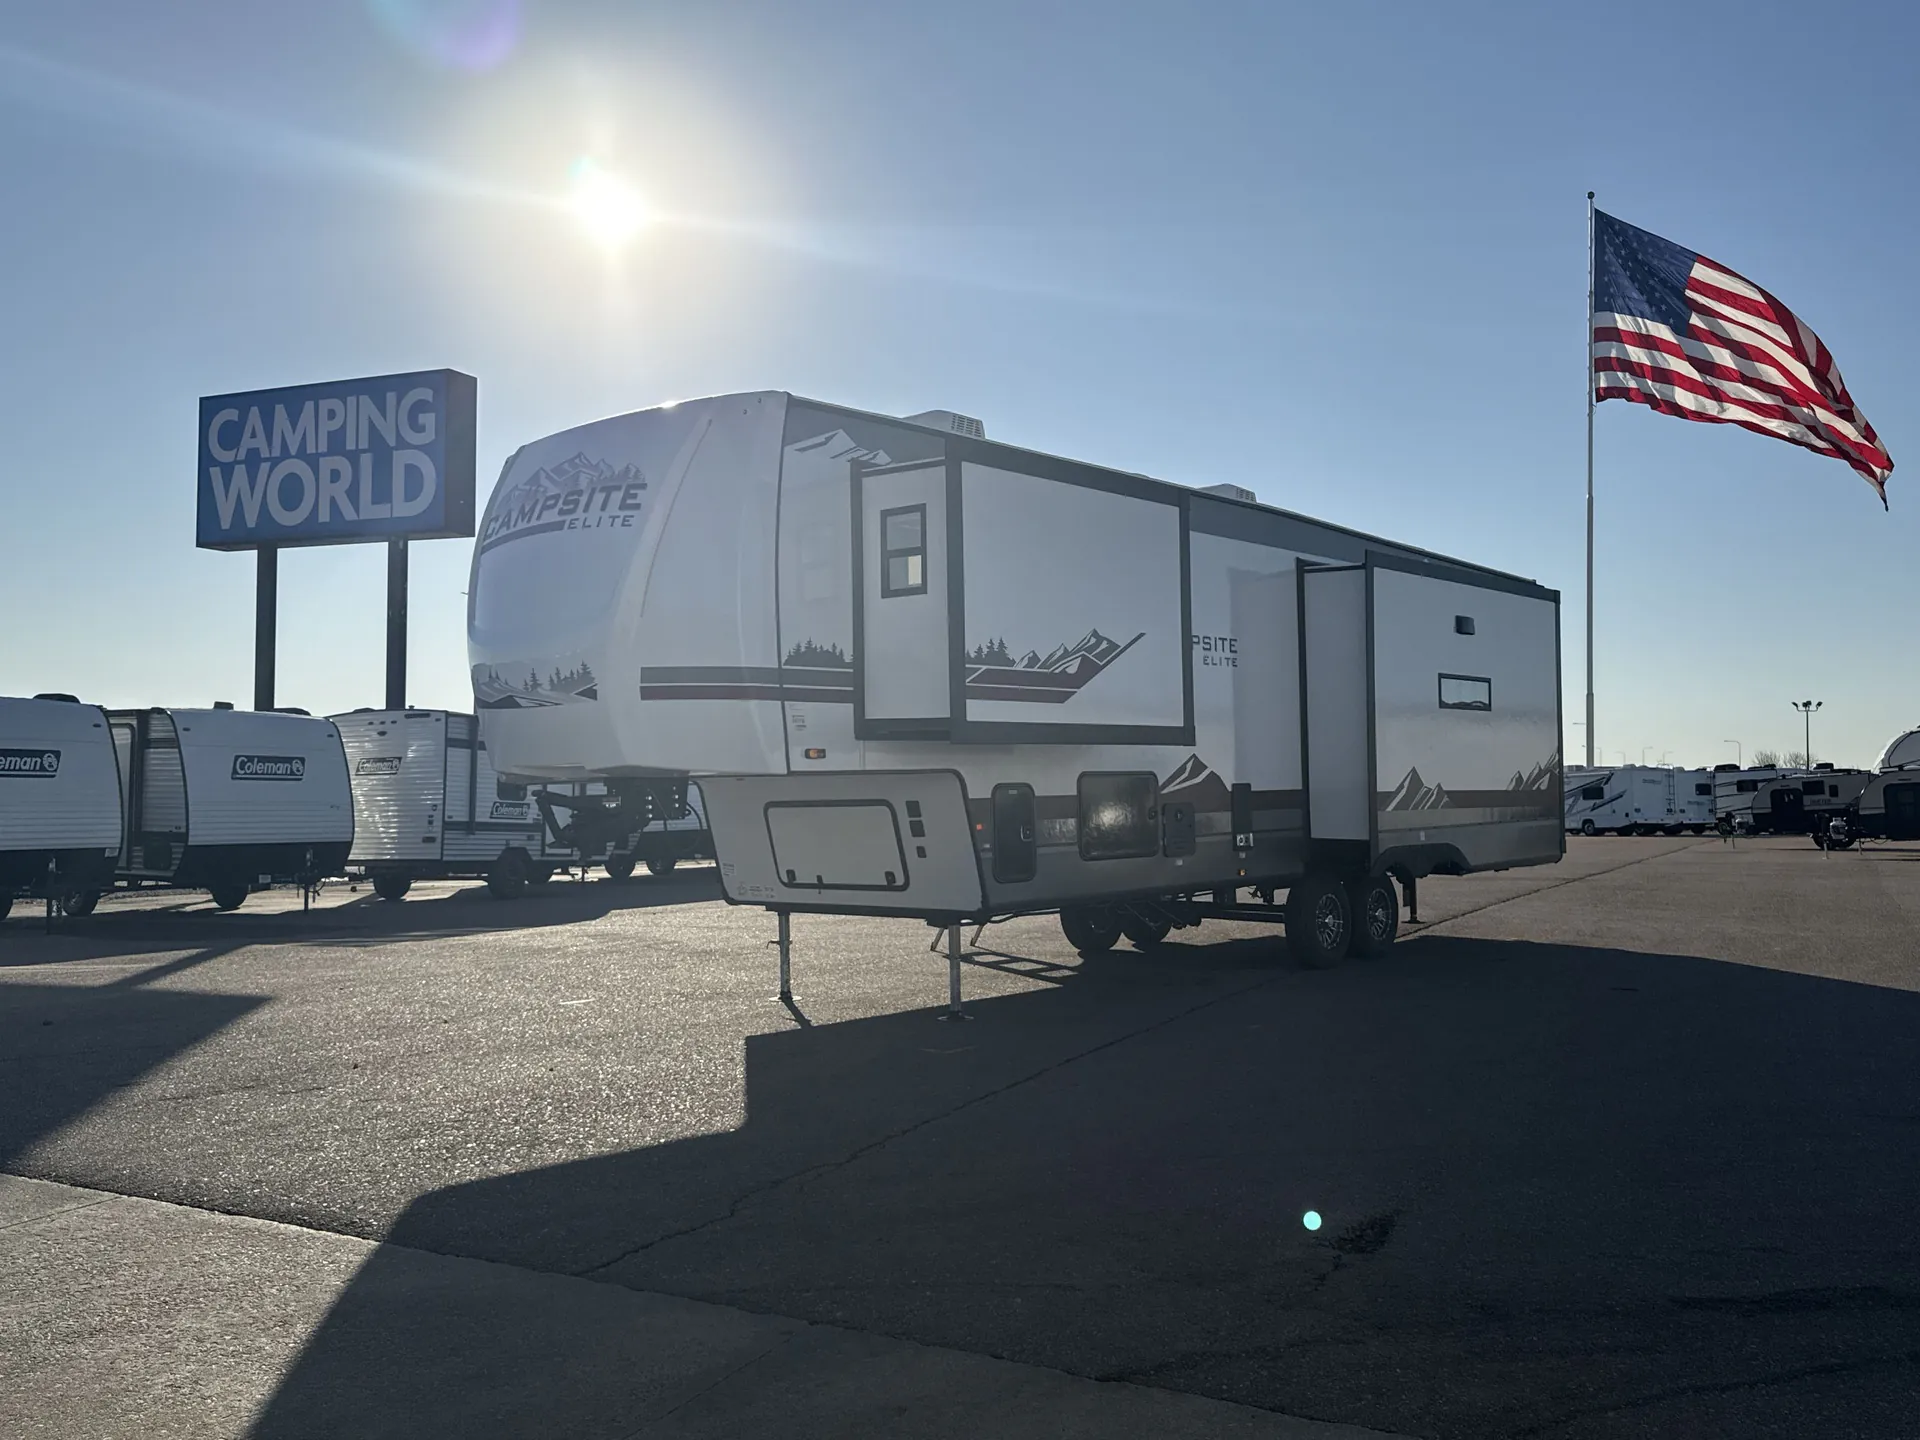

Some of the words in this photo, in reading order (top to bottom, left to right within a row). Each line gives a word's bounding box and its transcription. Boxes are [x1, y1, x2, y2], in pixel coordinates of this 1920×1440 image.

[208, 387, 436, 463] CAMPING
[208, 449, 438, 530] WORLD
[484, 483, 648, 541] CAMPSITE
[567, 515, 635, 530] ELITE
[1202, 655, 1238, 668] ELITE
[236, 756, 291, 775] Coleman
